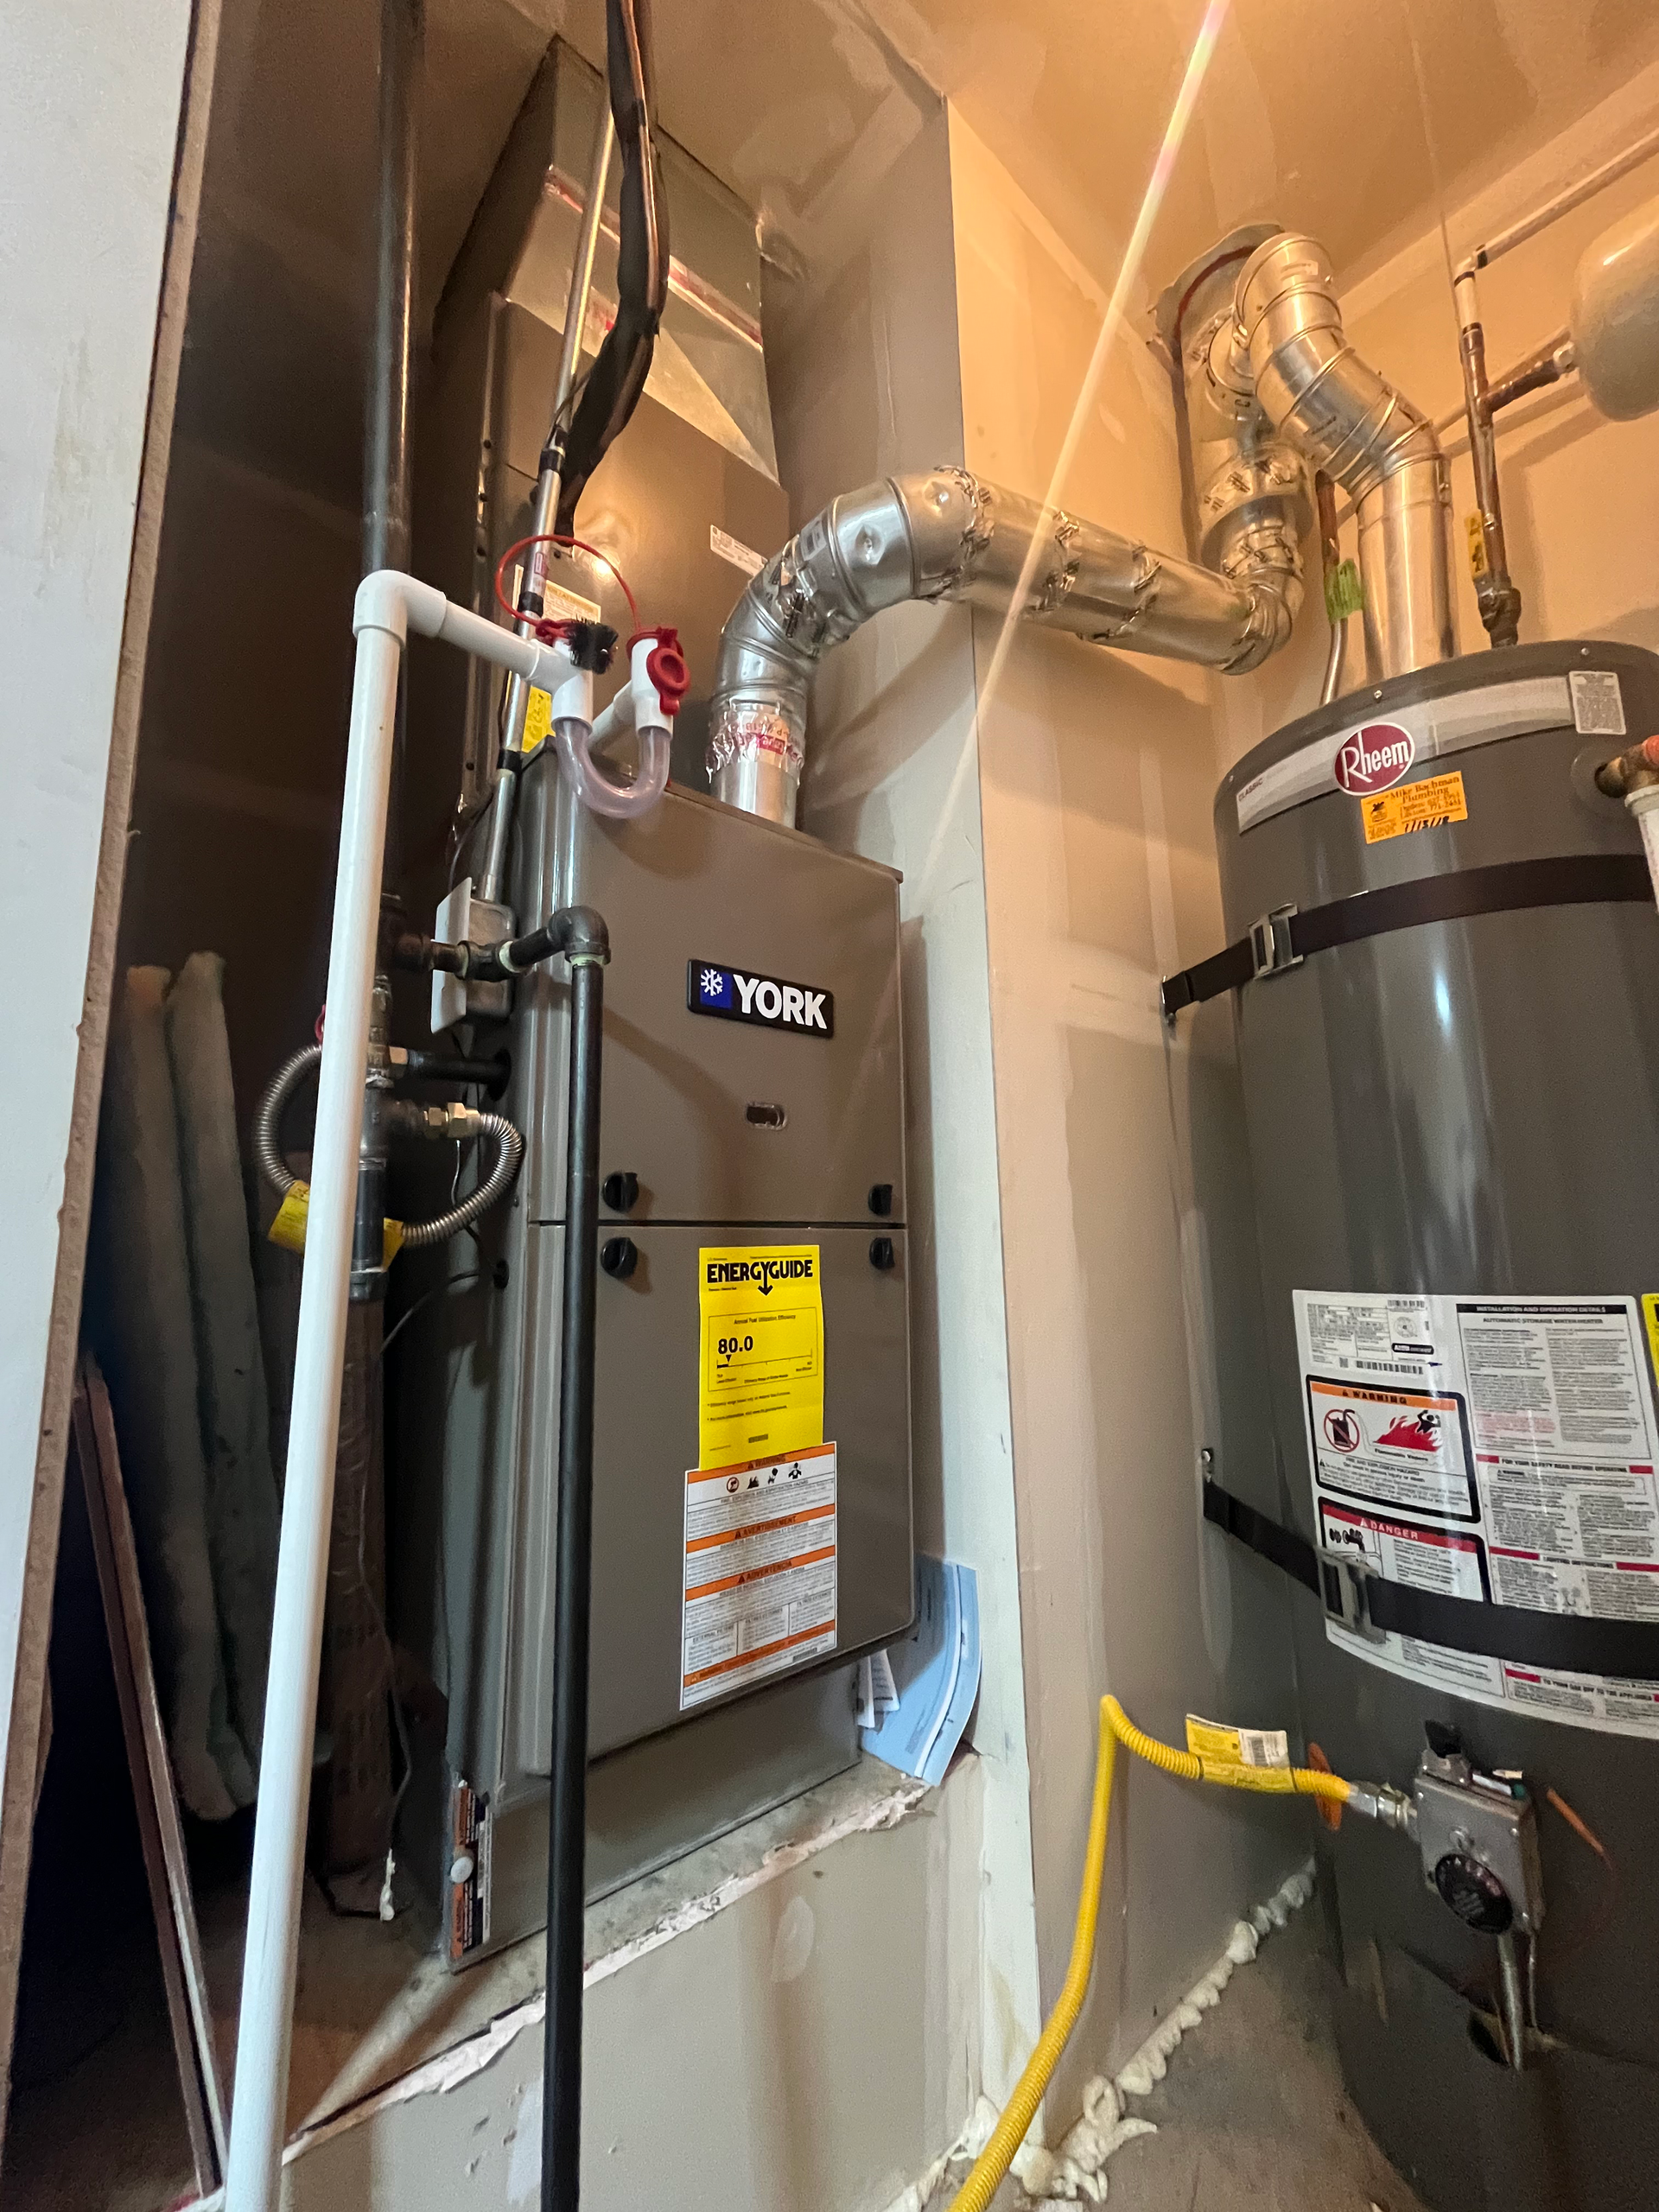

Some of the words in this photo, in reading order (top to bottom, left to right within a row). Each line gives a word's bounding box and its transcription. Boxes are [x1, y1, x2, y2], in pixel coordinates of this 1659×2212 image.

[1341, 730, 1409, 788] Rheem
[1390, 788, 1413, 799] Mike
[1415, 776, 1460, 792] Bachman
[1402, 787, 1449, 804] Plumbing
[733, 974, 828, 1029] YORK
[707, 1259, 813, 1284] ENERGYGUIDE
[718, 1335, 753, 1355] 80.0
[1352, 1389, 1408, 1405] WARNING
[1370, 1521, 1419, 1540] DANGER
